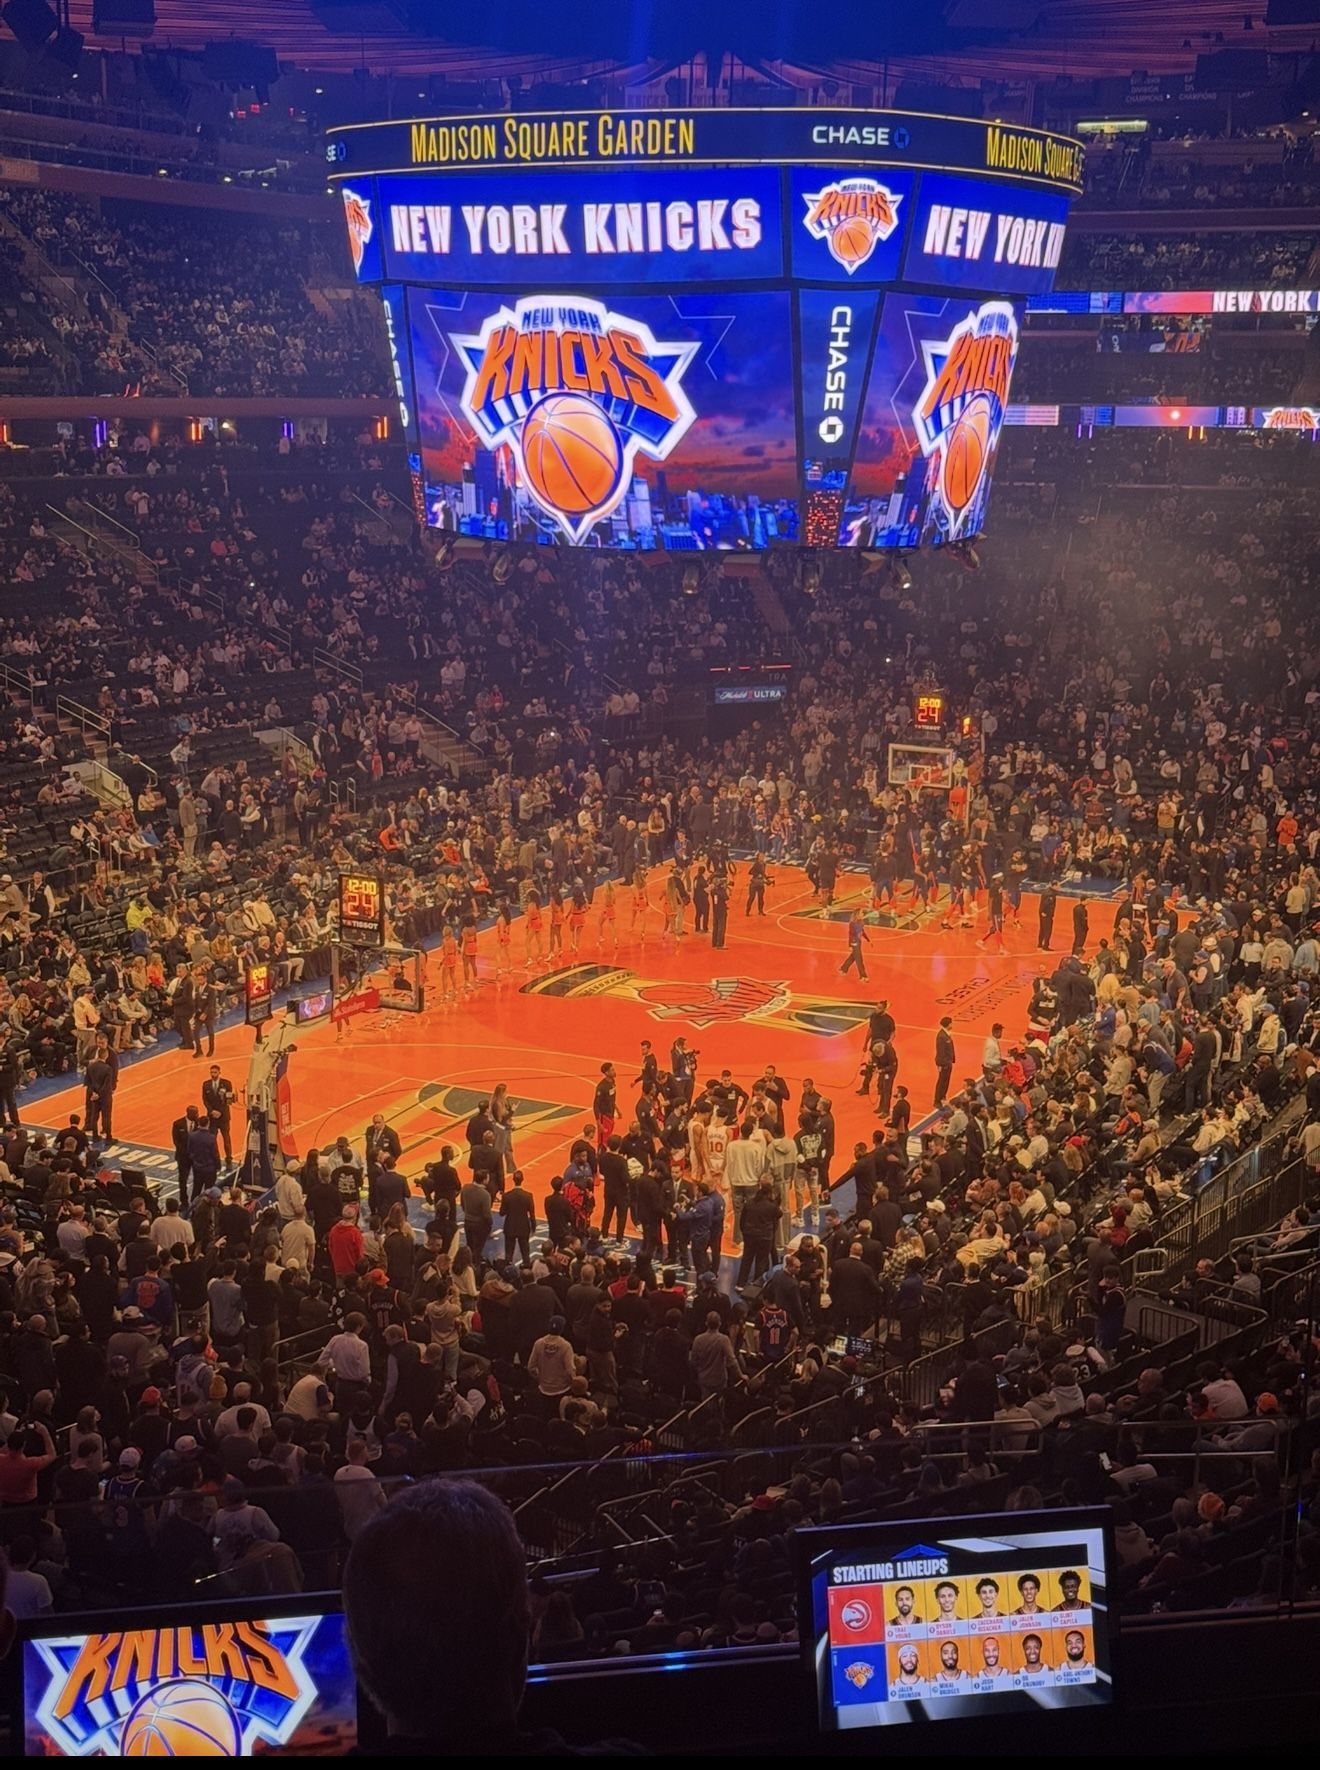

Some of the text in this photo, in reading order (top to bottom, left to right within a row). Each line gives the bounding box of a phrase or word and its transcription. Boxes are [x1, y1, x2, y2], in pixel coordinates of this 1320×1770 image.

[411, 114, 694, 163] MADISON SQUARE GARDEN
[812, 125, 890, 146] CHASE
[986, 127, 1043, 173] MADISON
[809, 191, 894, 225] KNICKS
[390, 197, 762, 255] NEW YORK KNICKS
[923, 204, 992, 259] NEW
[994, 213, 1048, 267] YORK
[1213, 291, 1253, 313] NEW
[1260, 290, 1312, 313] YORK
[521, 307, 603, 332] NEW YORK
[824, 306, 851, 411] CHASE
[470, 326, 682, 423] KNICKS
[753, 690, 782, 698] ULTRA
[919, 697, 941, 708] 12:00
[917, 706, 939, 723] 24
[348, 879, 377, 895] 12:00
[346, 893, 375, 919] 24
[352, 919, 379, 930] TISSOT
[709, 1141, 723, 1153] 10
[1071, 1364, 1091, 1381] 23
[833, 1558, 949, 1583] STARTING LINEUPS
[52, 1620, 302, 1721] KNICKS
